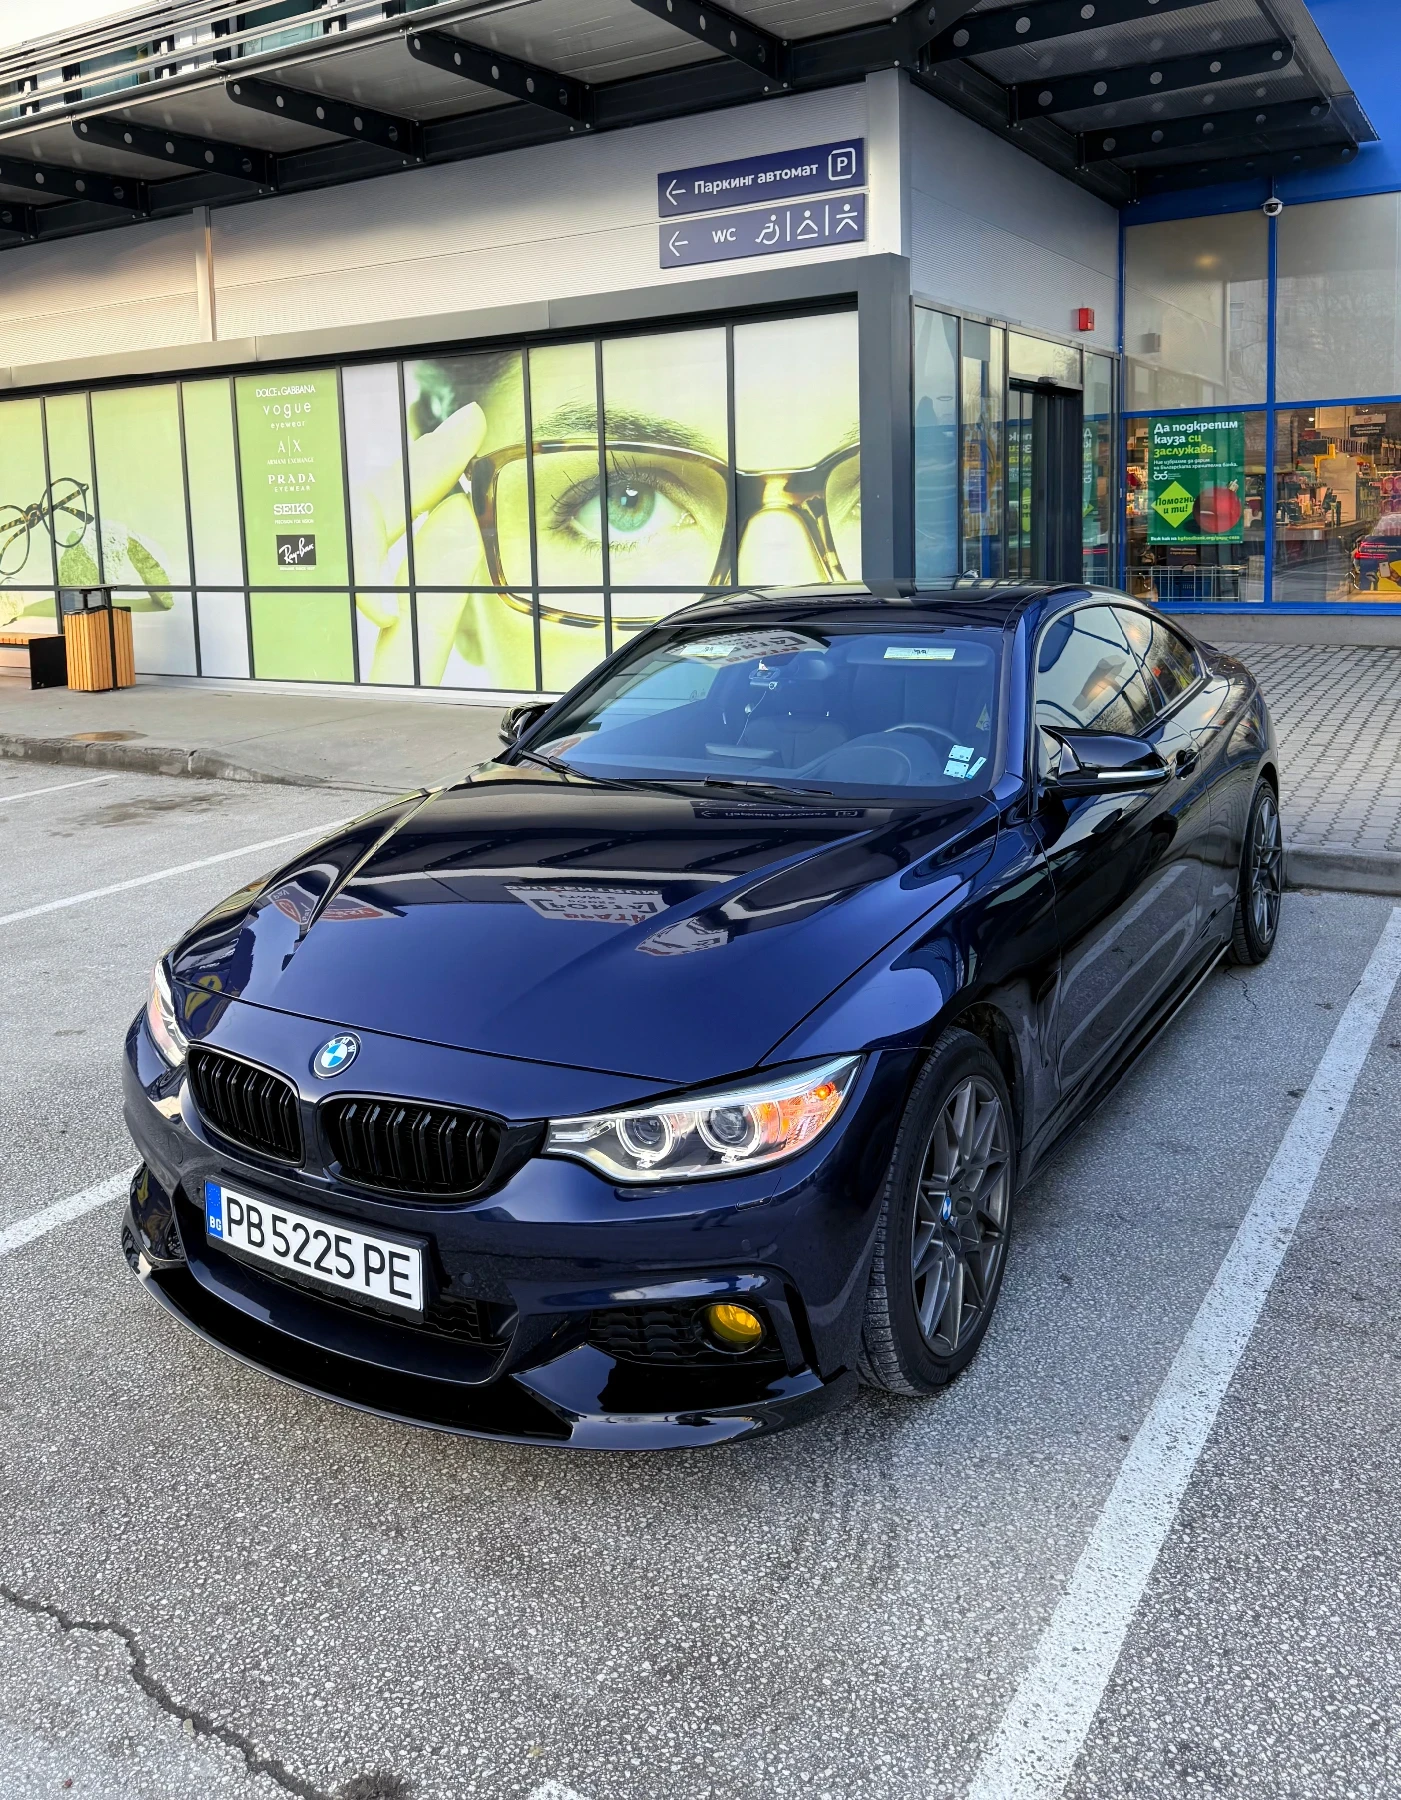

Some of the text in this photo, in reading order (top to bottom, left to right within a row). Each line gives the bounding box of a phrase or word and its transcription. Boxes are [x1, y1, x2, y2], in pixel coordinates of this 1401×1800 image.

[694, 174, 755, 195] Паркинг
[757, 163, 819, 184] автомат
[711, 227, 737, 244] WC
[262, 402, 312, 419] vogue
[270, 420, 306, 431] eyewear
[1153, 420, 1239, 434] Да подкрепим
[1154, 434, 1186, 446] кауза
[1188, 434, 1202, 443] си
[1153, 443, 1218, 458] заслужава.
[287, 456, 315, 465] EXCHANGE
[267, 472, 316, 485] PRADA
[274, 485, 311, 493] EYEWEAR
[1155, 496, 1196, 507] Помогни
[273, 502, 314, 515] SEIKO
[1171, 504, 1189, 513] ти!
[209, 1215, 222, 1232] BG
[226, 1196, 413, 1300] PB 5225 PE
